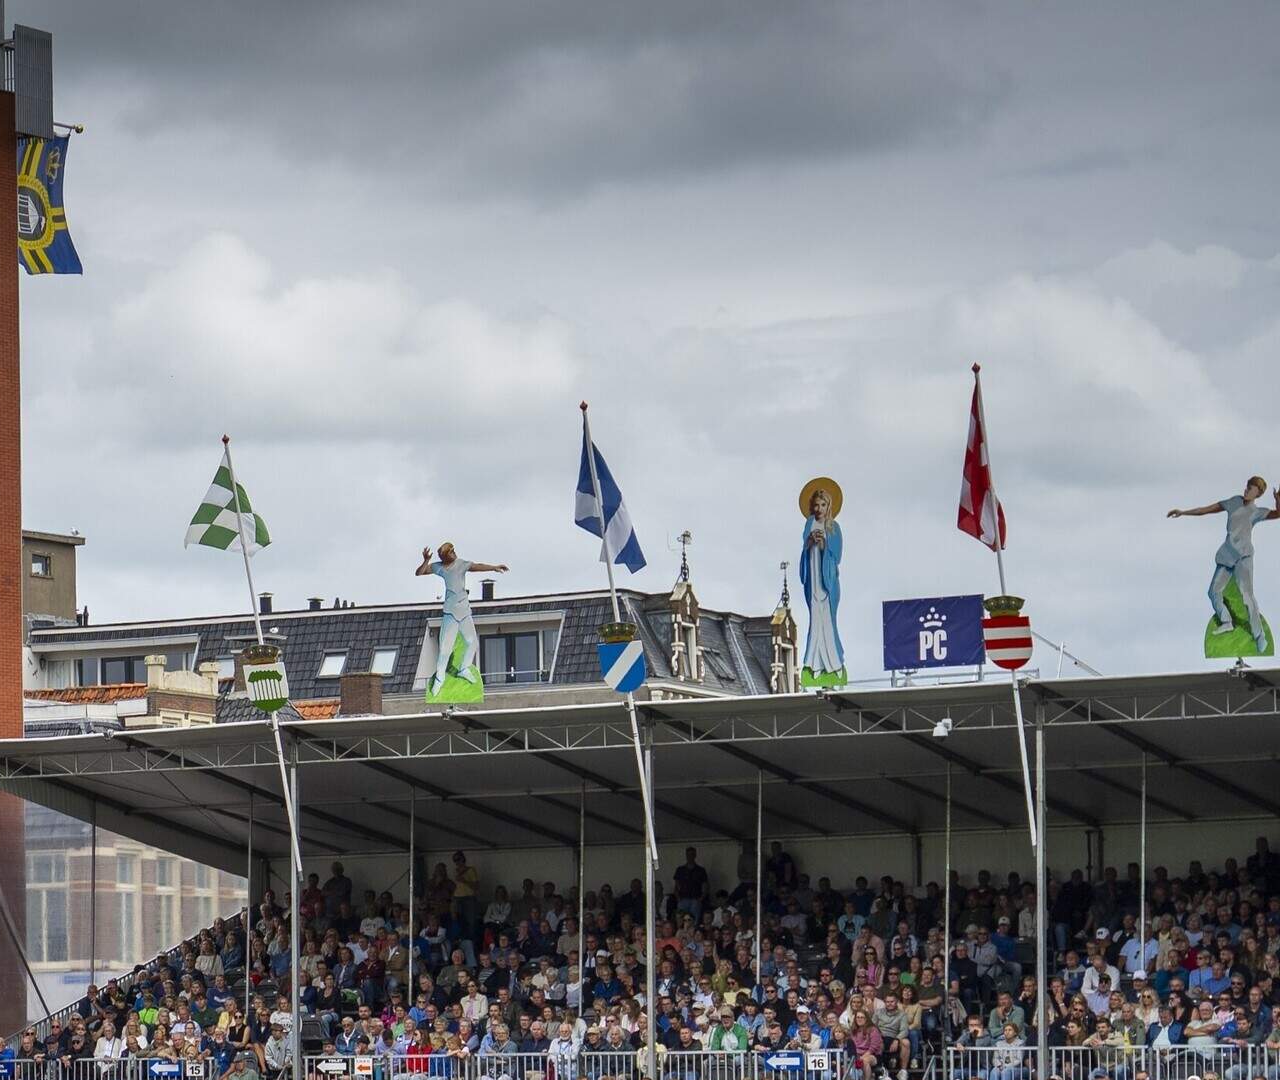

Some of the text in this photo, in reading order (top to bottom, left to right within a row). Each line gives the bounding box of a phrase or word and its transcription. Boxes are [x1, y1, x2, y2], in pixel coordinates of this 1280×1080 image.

[919, 629, 947, 660] PC
[811, 1058, 824, 1069] 16
[189, 1065, 201, 1075] 15
